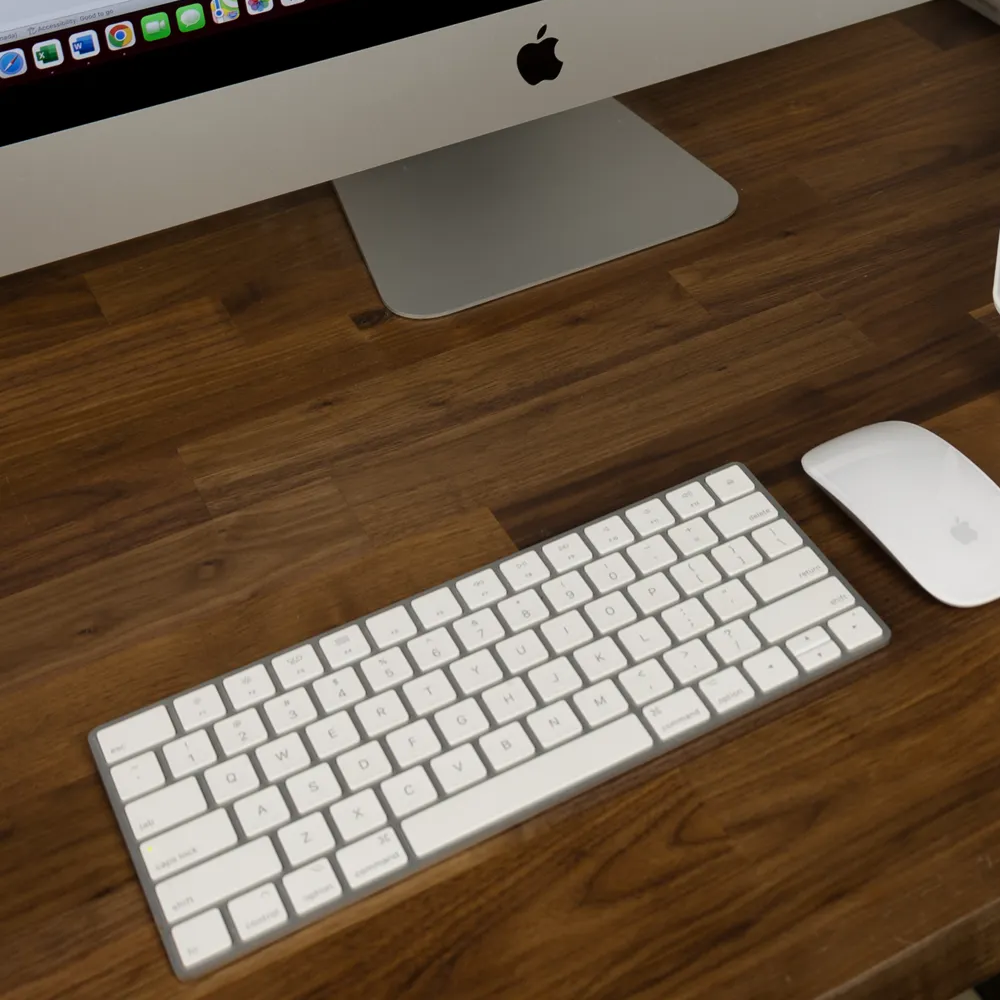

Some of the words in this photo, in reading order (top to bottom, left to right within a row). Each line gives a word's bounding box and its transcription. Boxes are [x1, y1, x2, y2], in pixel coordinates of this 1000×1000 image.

[80, 13, 97, 21] Good
[74, 42, 83, 50] W
[749, 508, 771, 521] delete
[609, 572, 618, 581] 0
[799, 565, 821, 578] return
[566, 591, 575, 599] 9
[648, 588, 657, 596] P
[522, 610, 531, 619] 8
[476, 628, 485, 639] 7
[639, 633, 650, 643] L
[432, 648, 441, 658] 6
[516, 645, 527, 656] U
[594, 652, 606, 663] K
[386, 668, 394, 678] 5
[471, 665, 480, 675] Y
[552, 673, 560, 683] J
[338, 689, 347, 698] 4
[424, 686, 433, 696] T
[503, 693, 515, 704] H
[594, 696, 607, 707] M
[288, 710, 298, 719] 3
[376, 707, 387, 717] R
[456, 714, 468, 726] G
[549, 717, 560, 729] N
[239, 732, 248, 742] 2
[328, 728, 338, 739] E
[408, 737, 417, 747] F
[501, 740, 512, 751] B
[188, 754, 196, 762] 1
[275, 749, 289, 761] W
[358, 759, 370, 770] D
[452, 761, 463, 772] V
[226, 773, 237, 783] Q
[308, 782, 319, 793] S
[404, 784, 415, 796] C
[258, 805, 267, 816] A
[352, 807, 364, 819] X
[301, 832, 312, 844] Z
